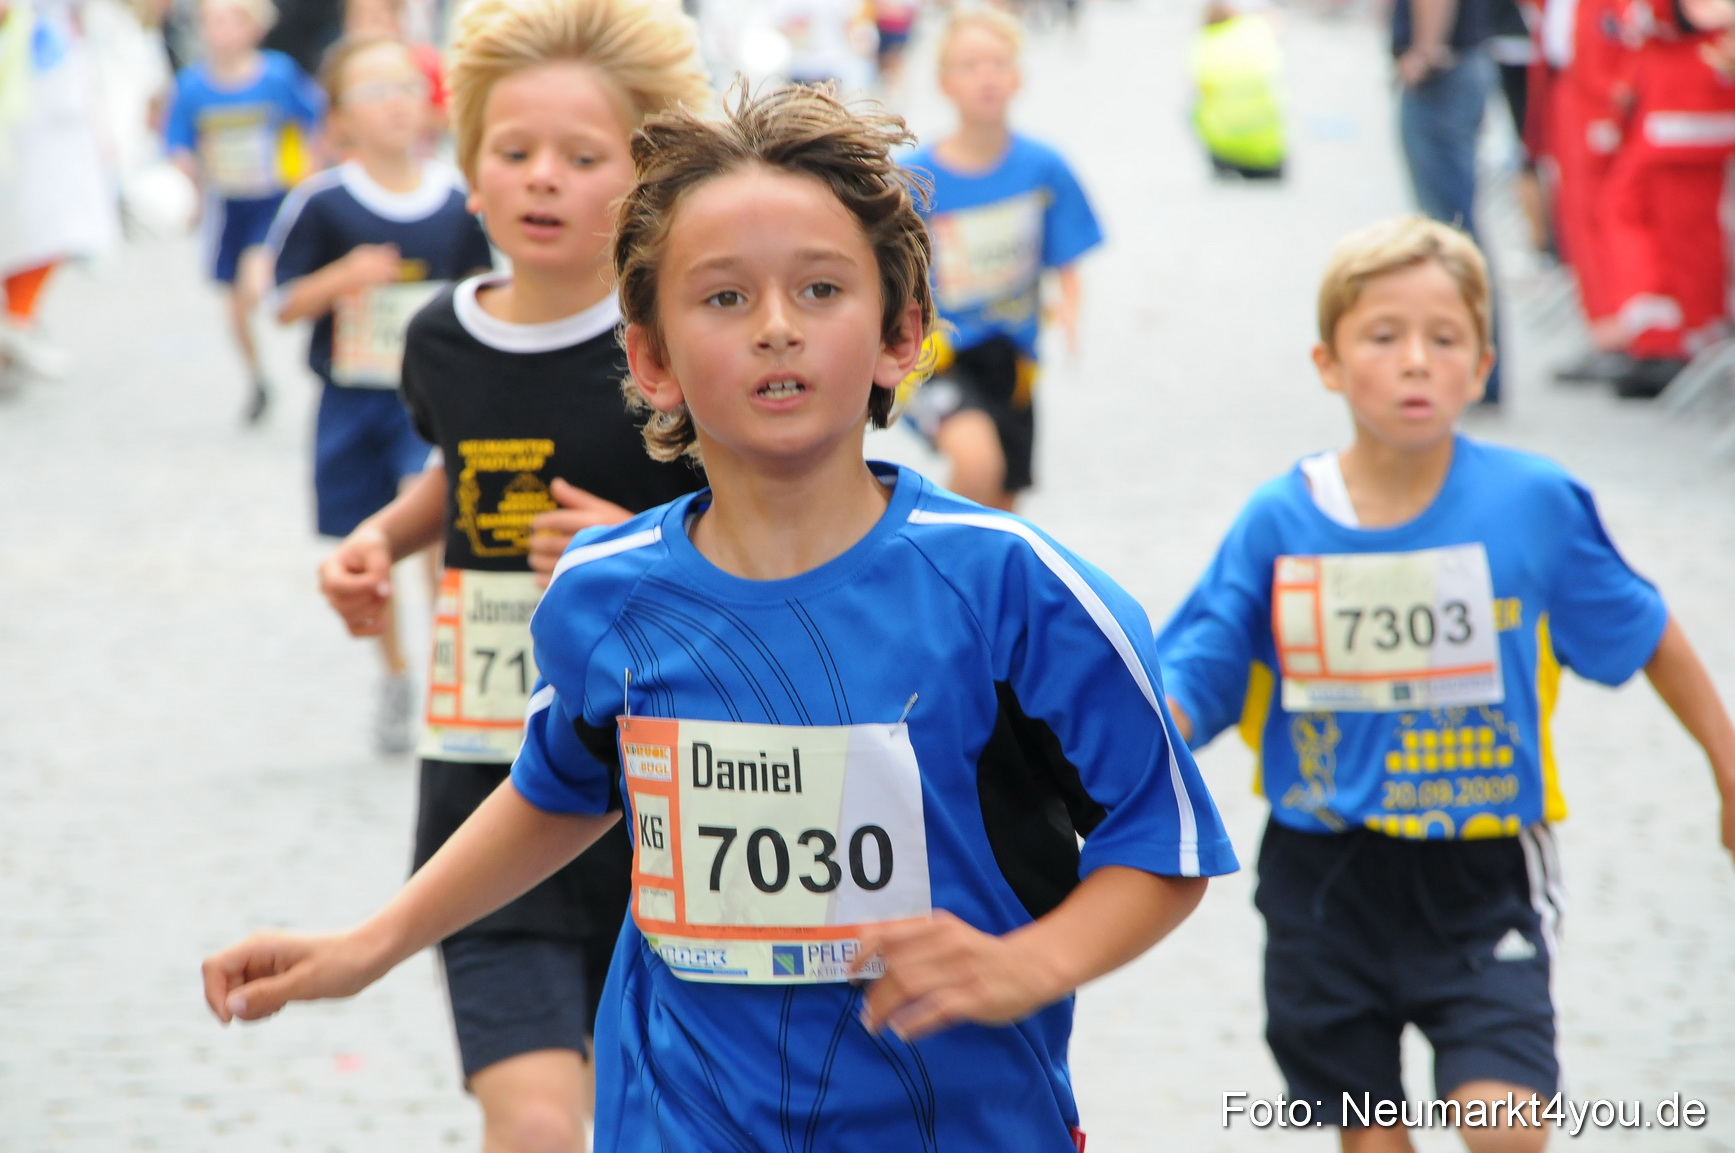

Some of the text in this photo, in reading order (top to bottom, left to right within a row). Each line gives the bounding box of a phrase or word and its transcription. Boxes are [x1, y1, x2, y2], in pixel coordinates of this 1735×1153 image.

[1337, 601, 1473, 655] 7303
[691, 740, 803, 794] Daniel
[697, 824, 894, 894] 7030
